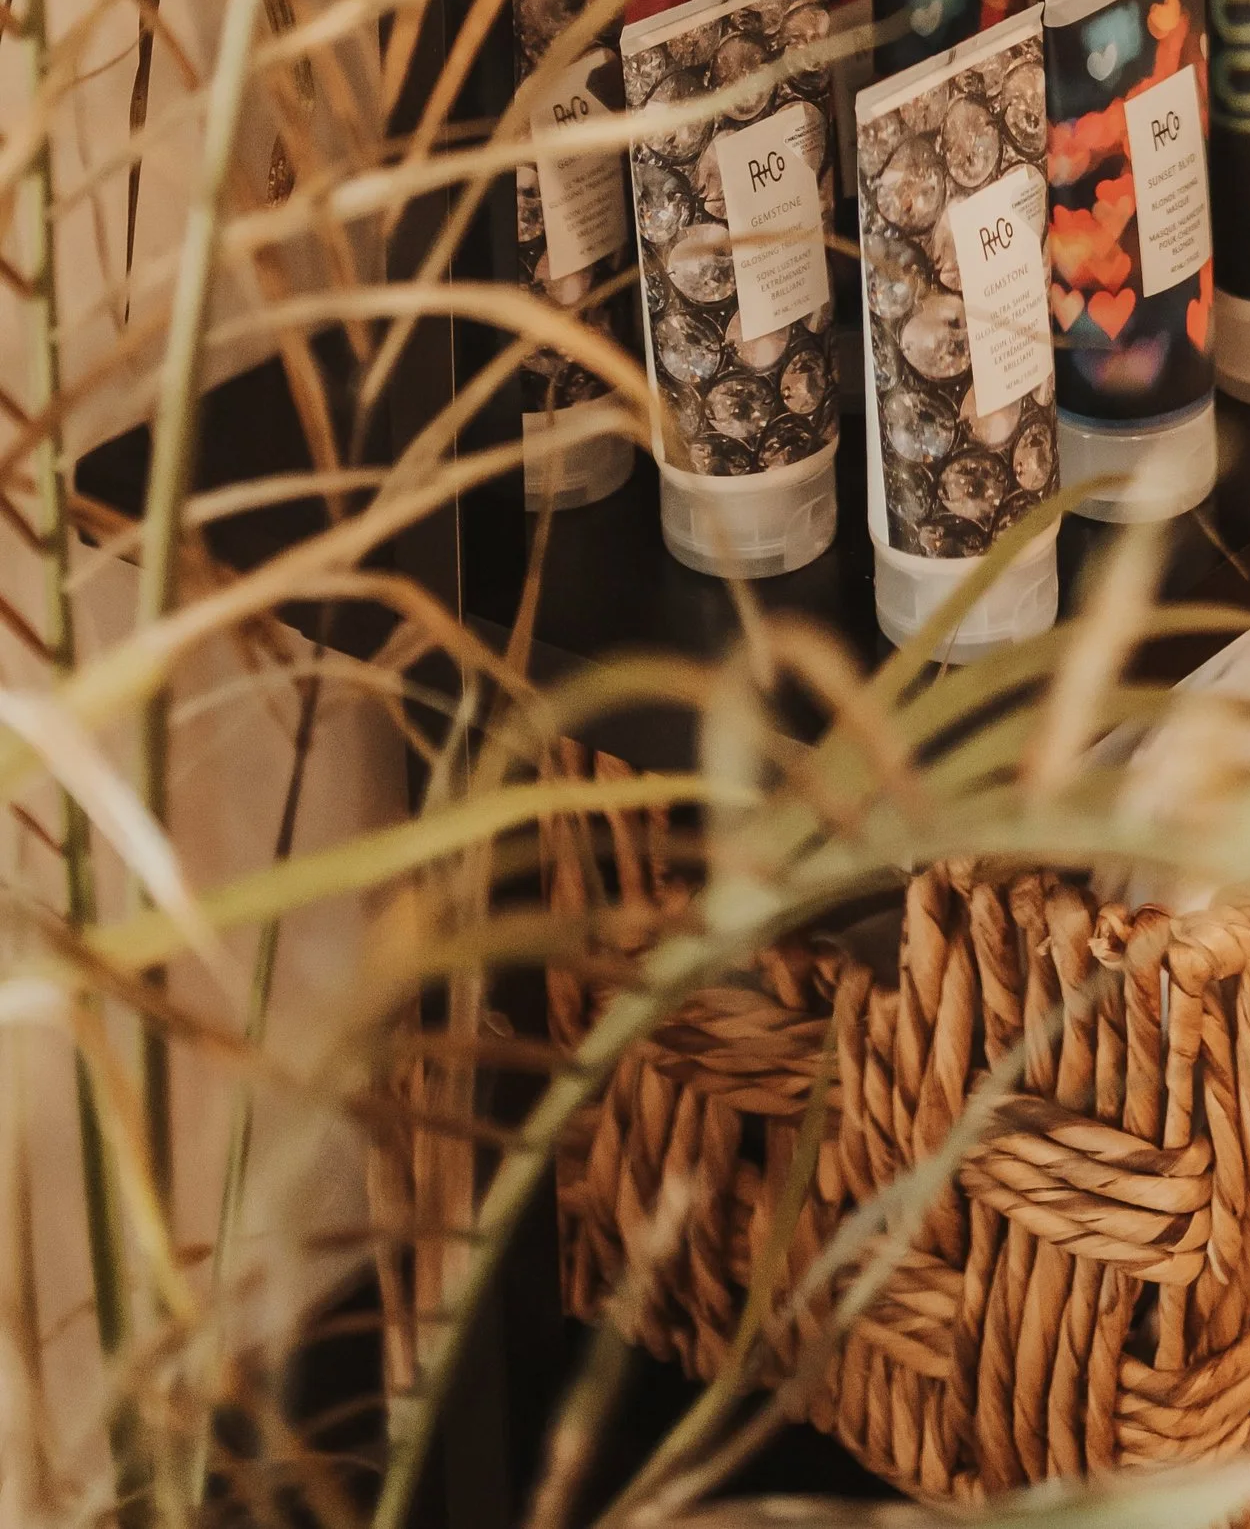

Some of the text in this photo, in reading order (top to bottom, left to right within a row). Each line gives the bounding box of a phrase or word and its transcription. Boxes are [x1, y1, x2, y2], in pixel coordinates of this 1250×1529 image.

[1151, 110, 1180, 152] R+Co
[748, 151, 785, 193] R+Co
[1147, 163, 1178, 189] SUNSET
[751, 196, 803, 229] GEMSTONE
[979, 216, 1014, 262] R+Co
[984, 264, 1029, 298] GEMSTONE
